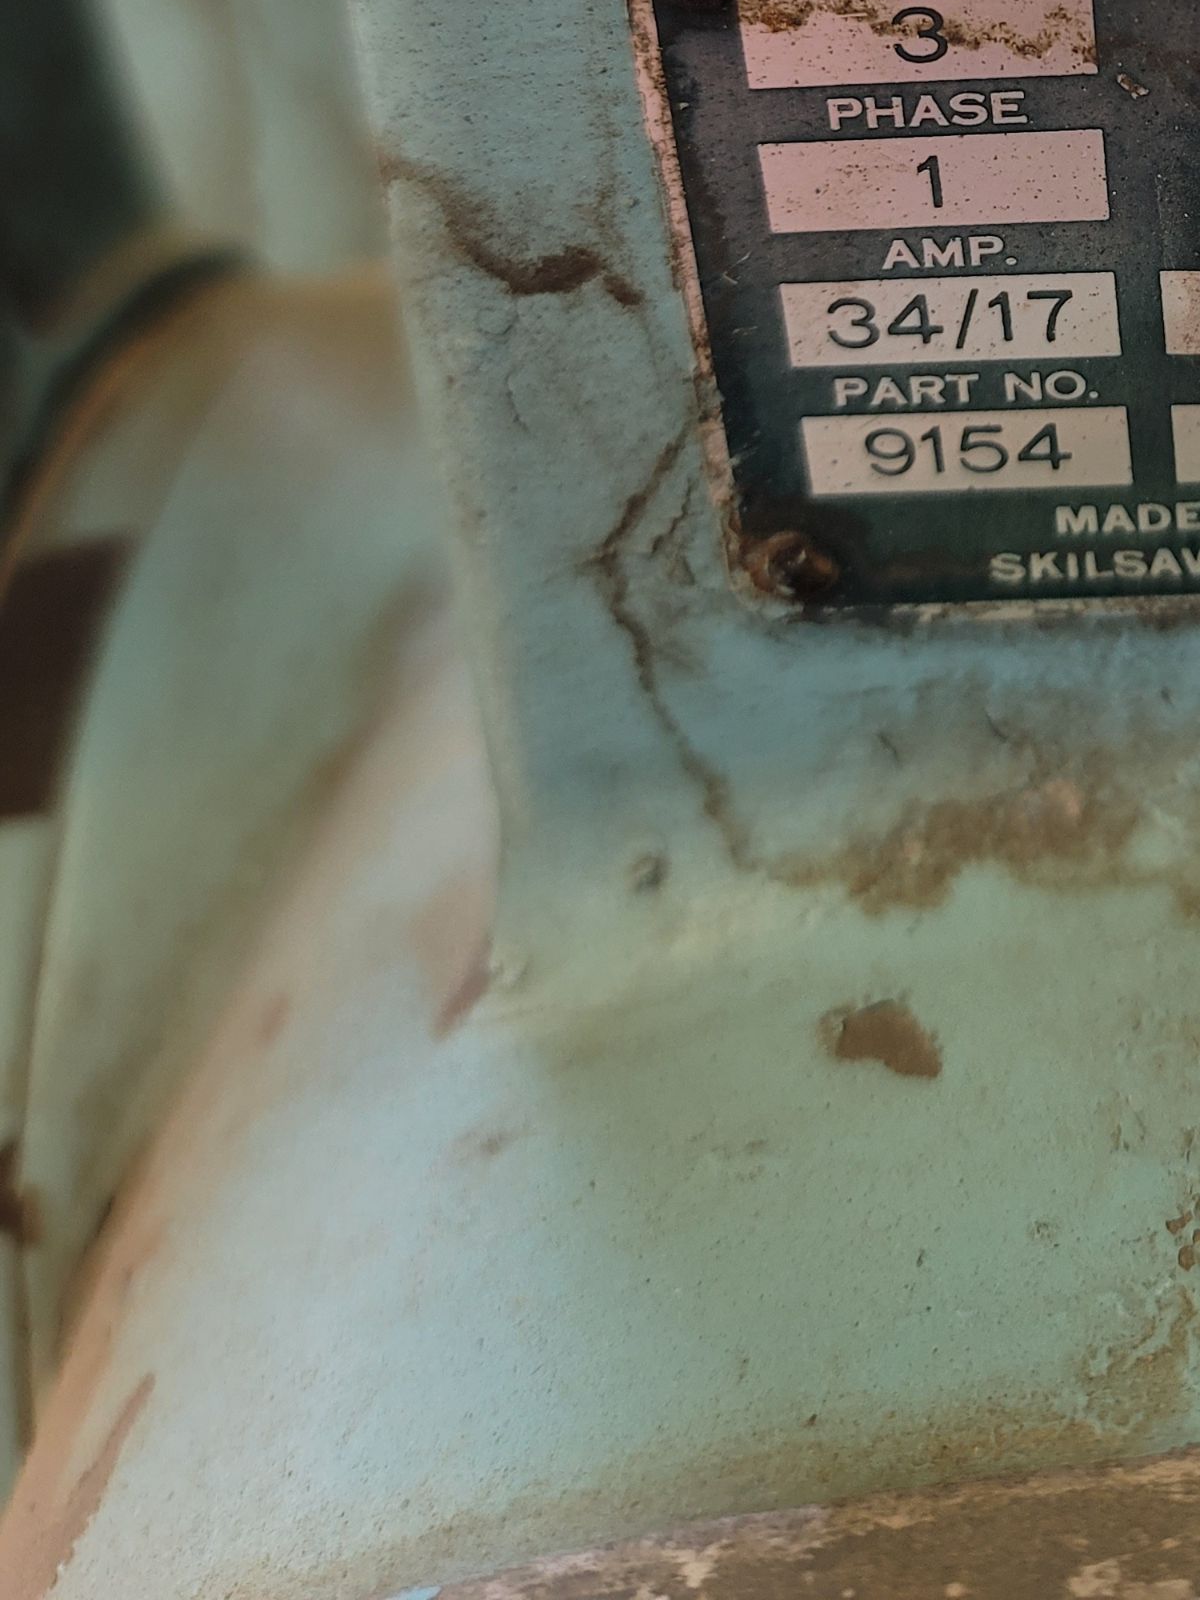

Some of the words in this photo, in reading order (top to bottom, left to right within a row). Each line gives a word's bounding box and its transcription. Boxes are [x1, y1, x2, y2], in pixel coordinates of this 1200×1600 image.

[891, 6, 949, 64] 3
[827, 91, 1028, 130] PHASE
[916, 155, 944, 209] 1
[882, 236, 1018, 269] AMP.
[827, 288, 1074, 349] 34/17
[834, 372, 980, 406] PART
[1003, 370, 1099, 399] NO.
[864, 423, 1072, 476] 9154
